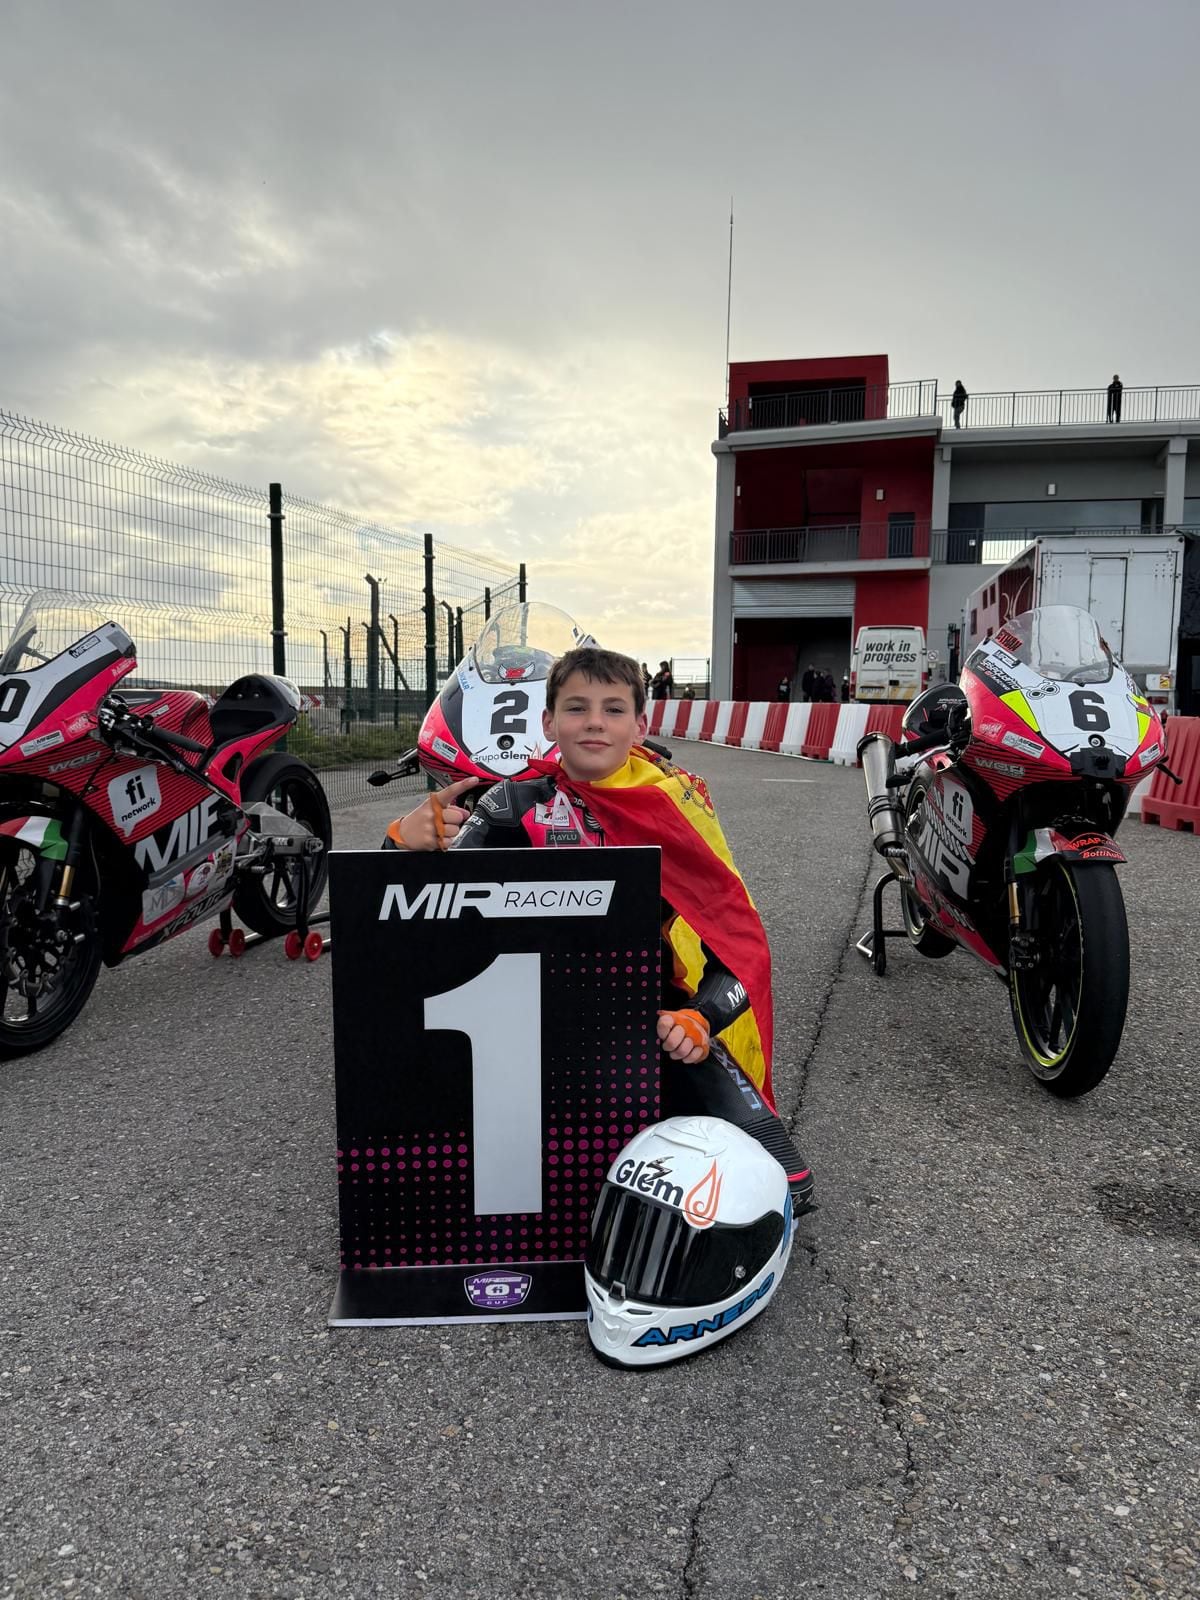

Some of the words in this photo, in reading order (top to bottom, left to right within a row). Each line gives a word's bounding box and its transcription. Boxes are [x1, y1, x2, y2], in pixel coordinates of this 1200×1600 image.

[862, 652, 917, 665] progress
[865, 640, 895, 652] work
[898, 640, 911, 652] in
[490, 690, 529, 735] 2
[1069, 691, 1111, 732] 6
[470, 752, 500, 763] Grupo
[500, 751, 530, 761] Glem
[125, 775, 146, 806] fi
[121, 797, 156, 823] network
[952, 791, 964, 822] fi
[549, 833, 577, 841] RAYLU
[945, 813, 968, 838] network
[1067, 837, 1101, 850] WRAP
[379, 881, 505, 921] MIR
[503, 890, 604, 909] RACING
[726, 981, 747, 1008] MI
[423, 953, 542, 1216] 1
[615, 1158, 684, 1207] Glem
[630, 1272, 775, 1347] ARNEDO
